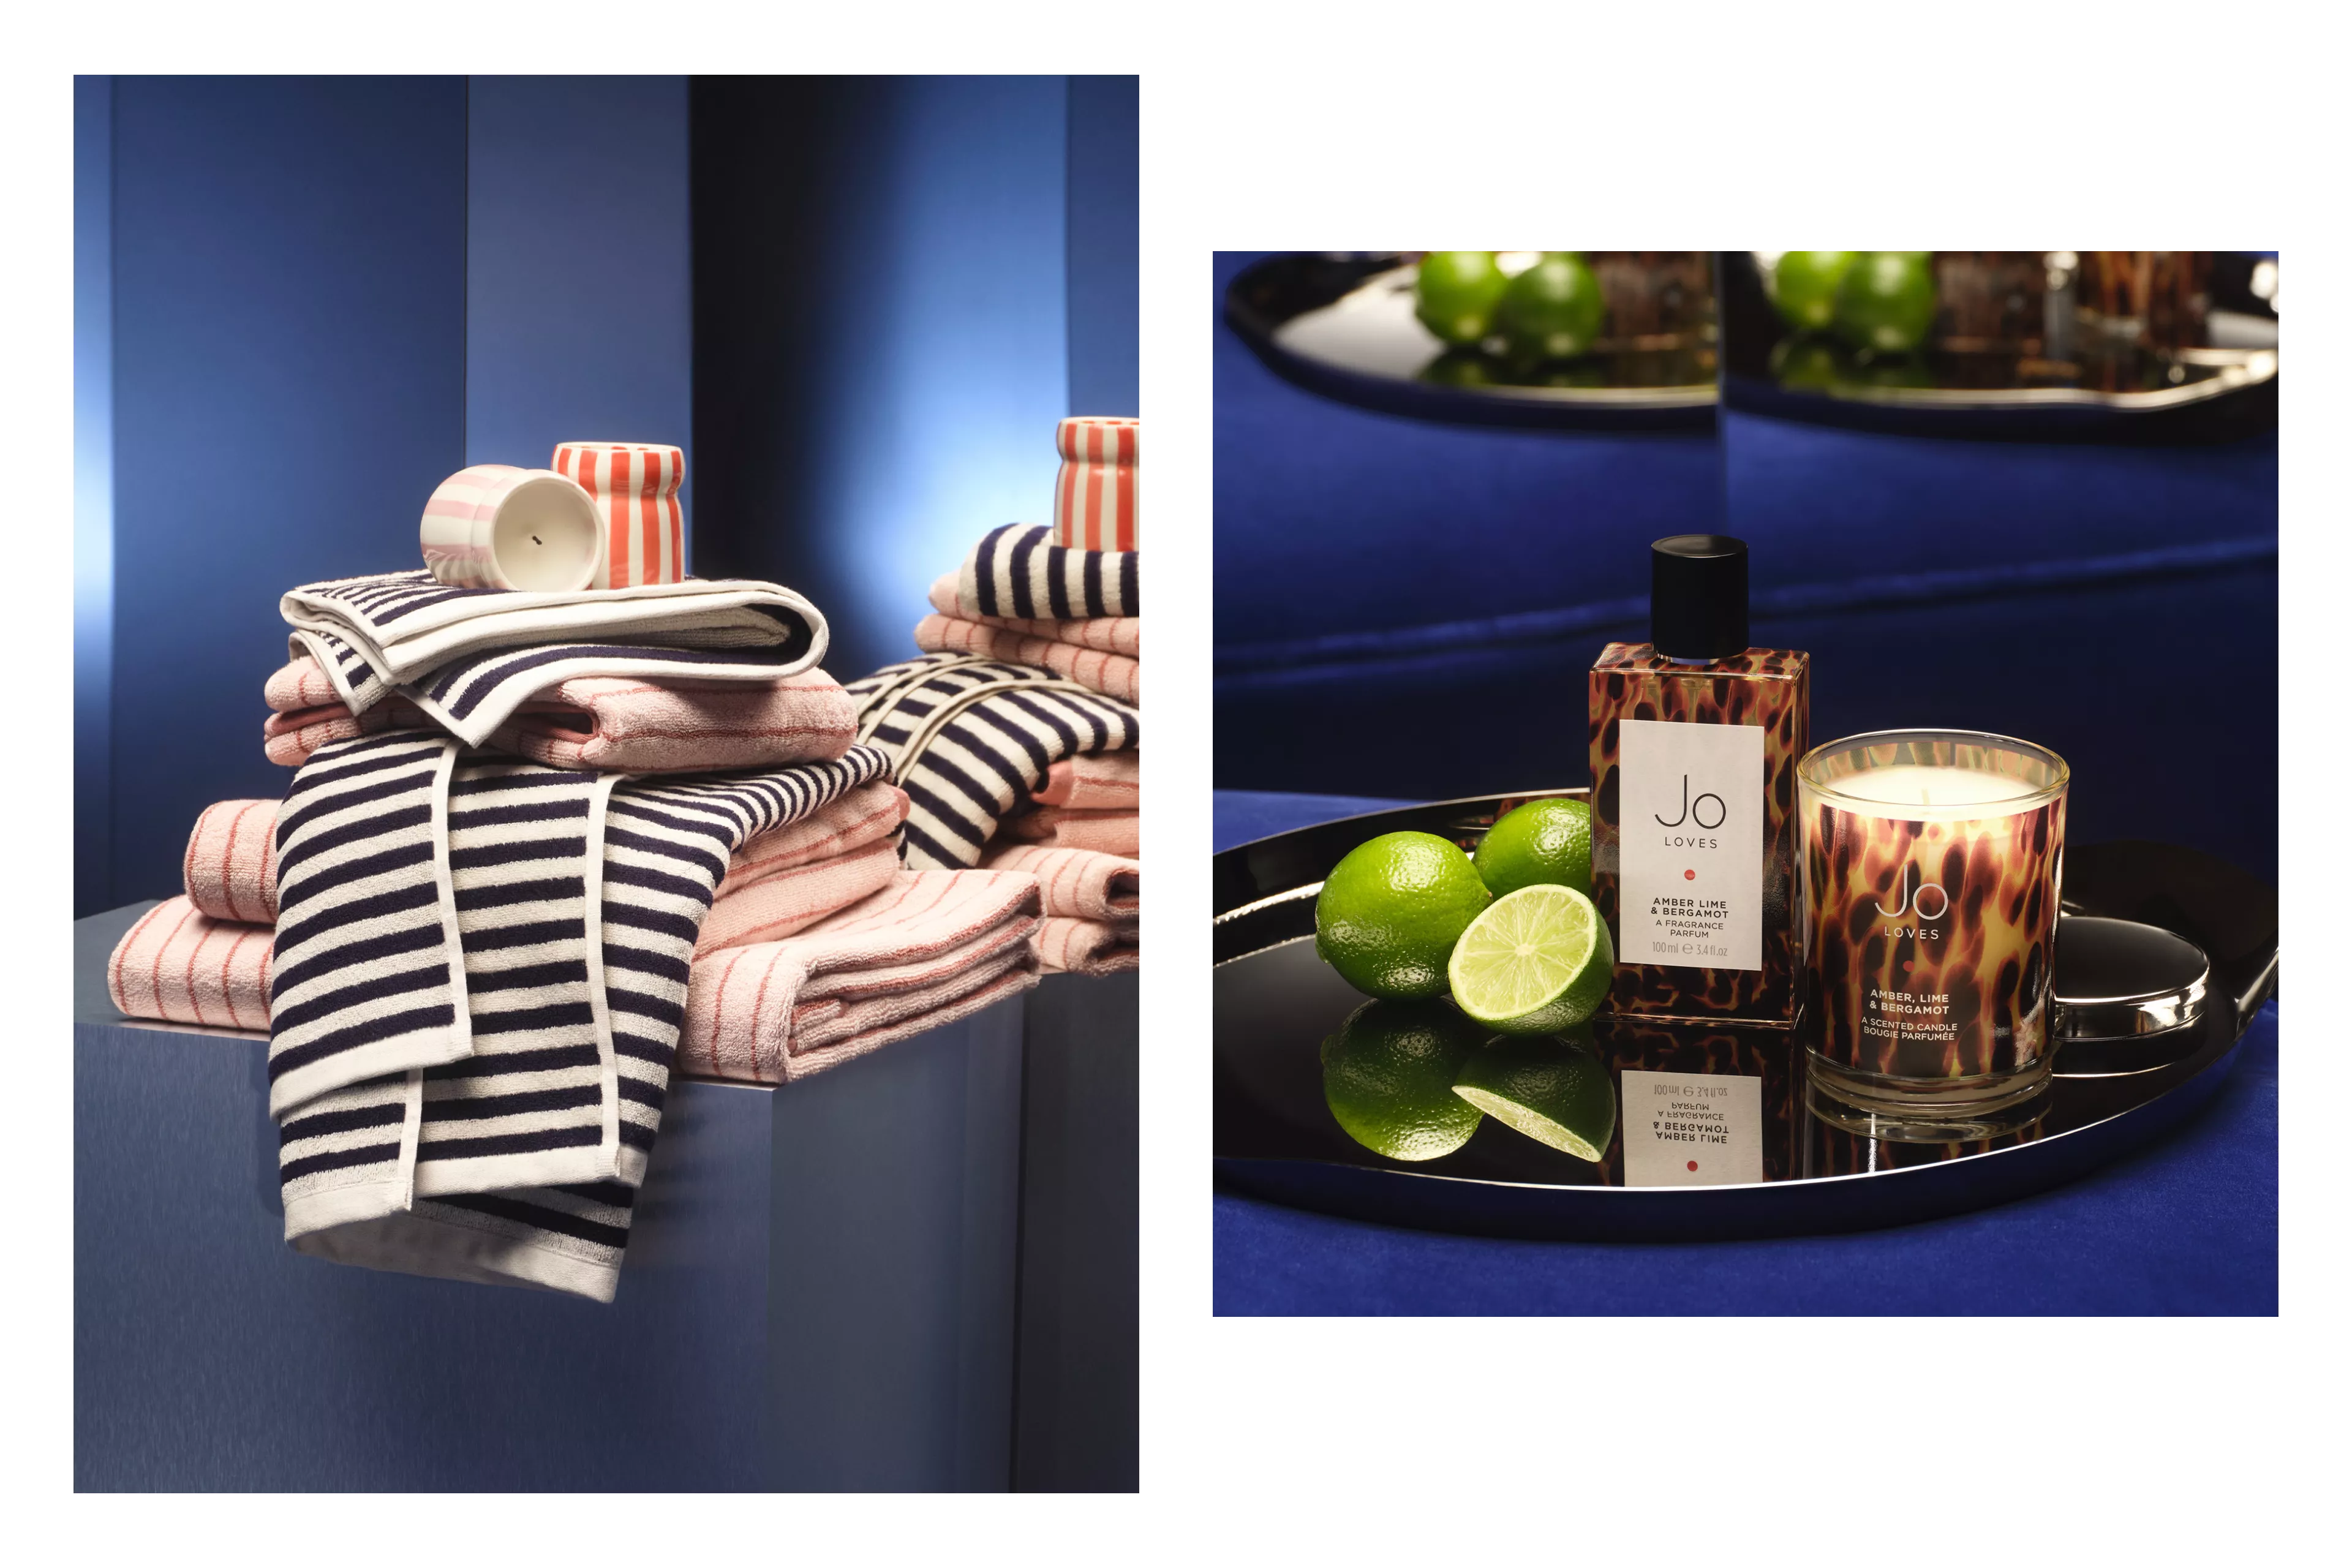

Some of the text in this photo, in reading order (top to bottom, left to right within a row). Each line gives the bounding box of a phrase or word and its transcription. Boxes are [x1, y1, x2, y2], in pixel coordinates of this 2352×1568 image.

[1655, 774, 1726, 829] Jo
[1665, 837, 1717, 848] LOVES
[1874, 864, 1948, 920] Jo
[1653, 897, 1726, 909] AMBER LIME
[1663, 907, 1728, 918] BERGAMOT
[1665, 920, 1724, 930] FRAGRANCE
[1670, 929, 1709, 938] PARFUM
[1885, 926, 1939, 940] LOVES
[1870, 989, 1949, 1003] AMBER, LIME
[1869, 1000, 1949, 1014] & BERGAMOT
[1871, 1018, 1914, 1030] SCENTED
[1864, 1026, 1954, 1041] BOUGIE PARFUMÉE
